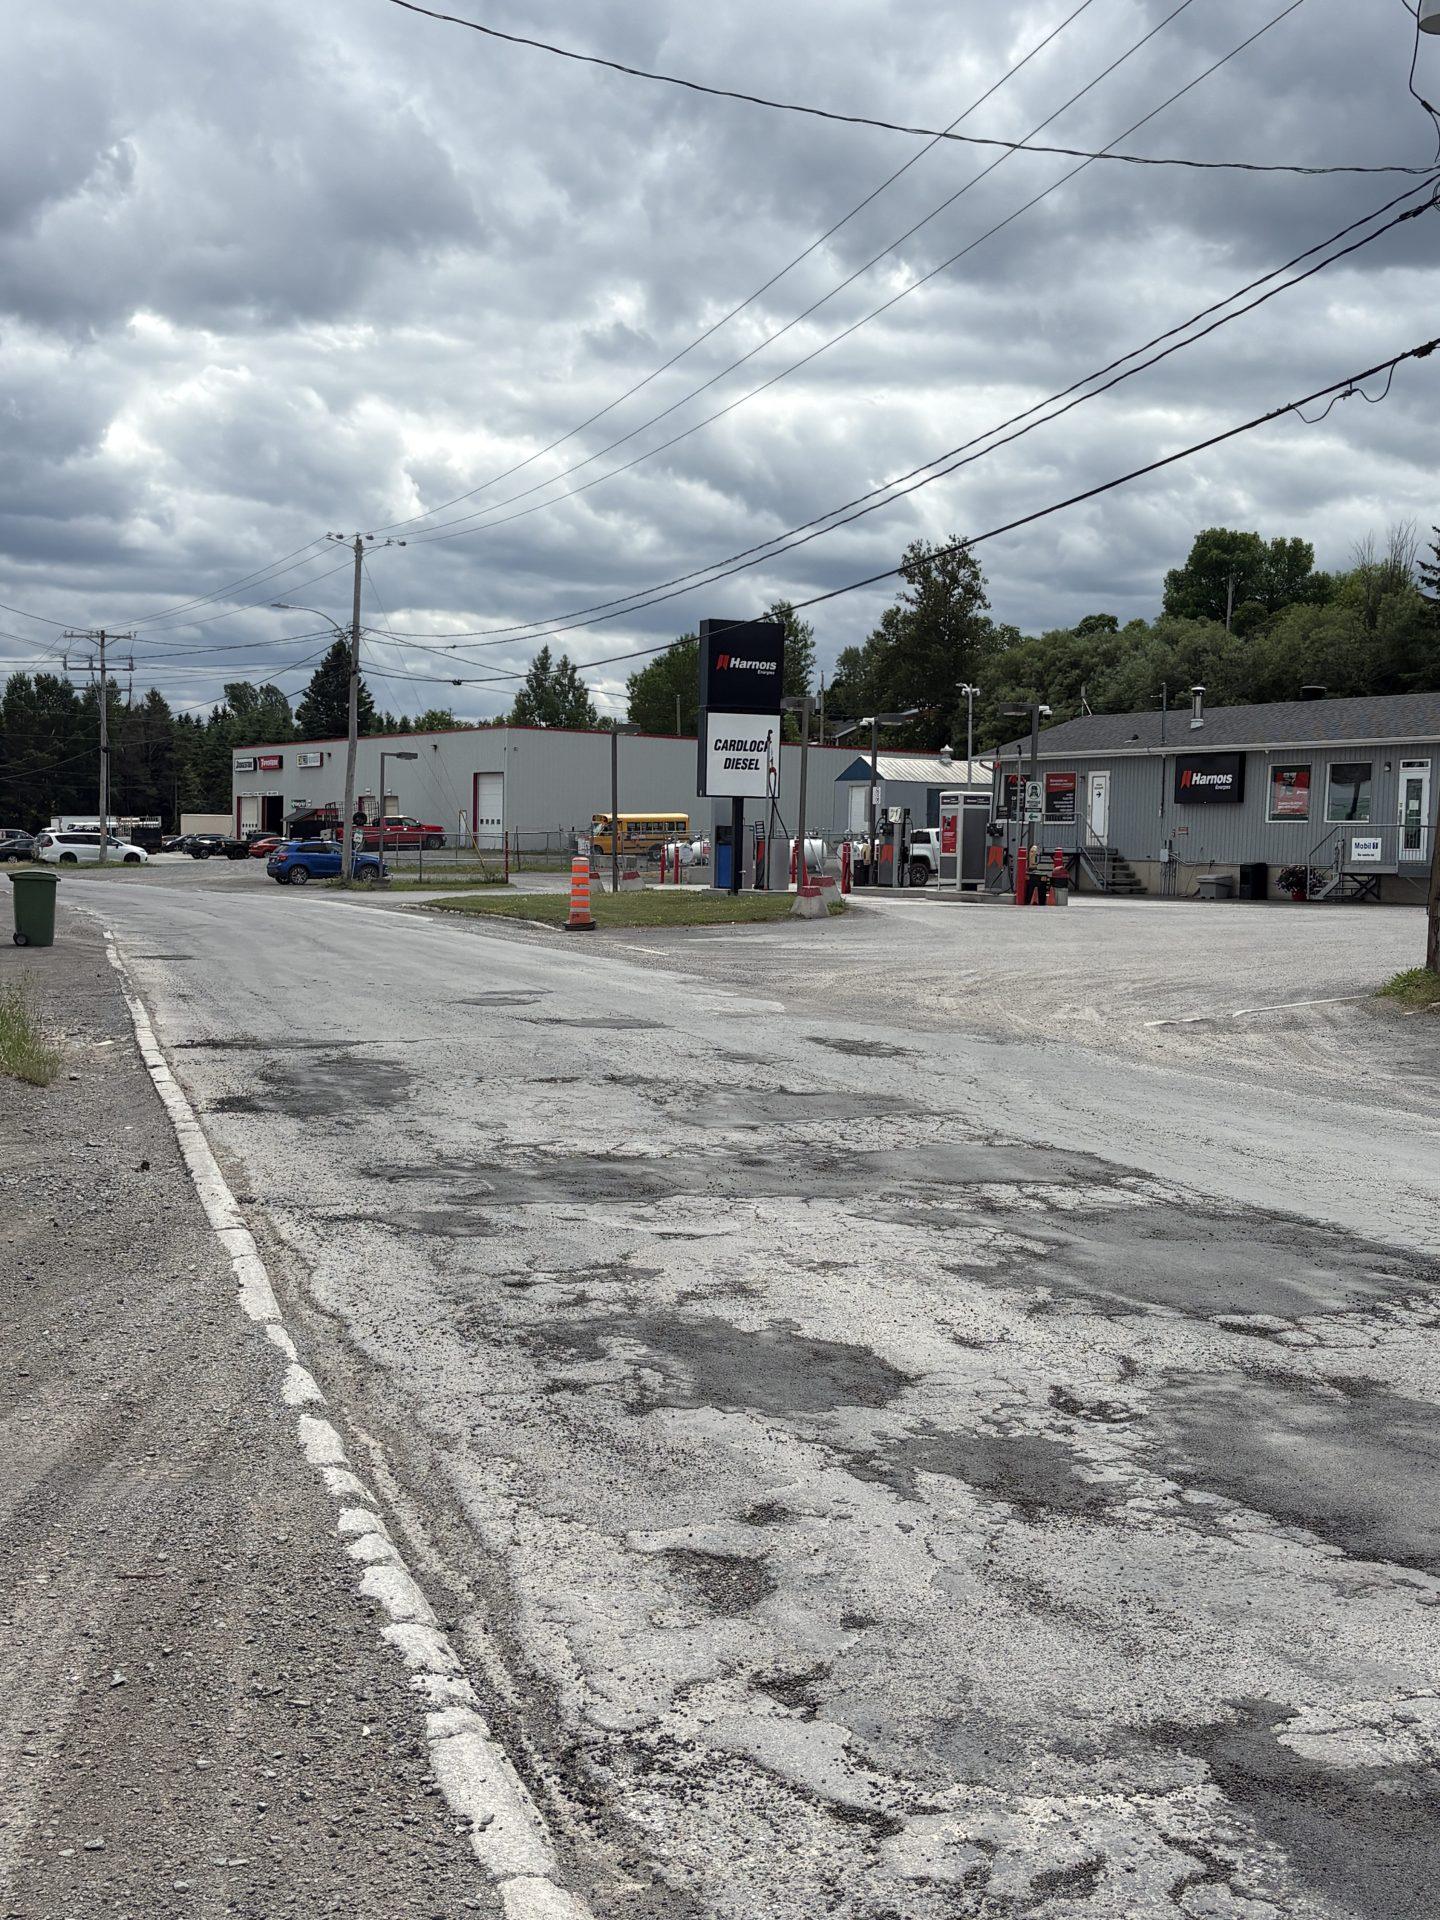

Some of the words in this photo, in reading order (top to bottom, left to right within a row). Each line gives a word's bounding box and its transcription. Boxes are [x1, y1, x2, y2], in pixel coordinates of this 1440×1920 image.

[729, 657, 777, 670] Harnois
[723, 758, 760, 770] DIESEL
[1191, 773, 1233, 785] Harnois
[1354, 841, 1371, 850] Mobil
